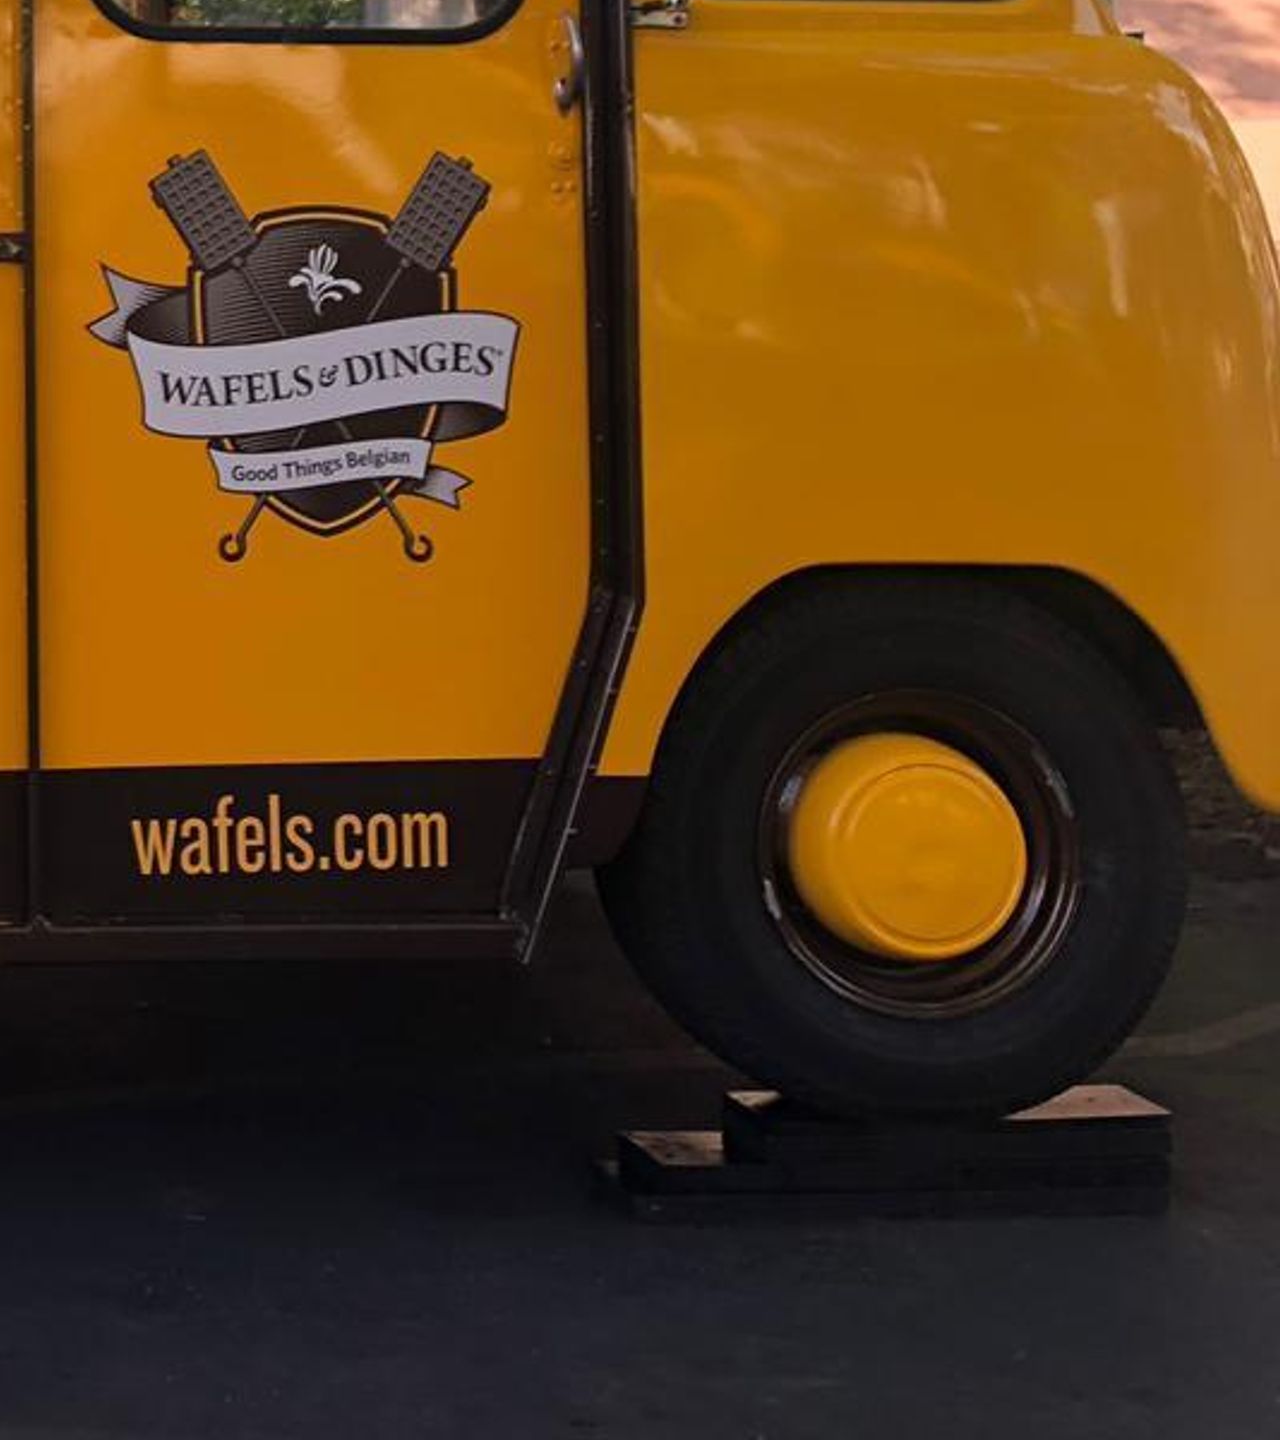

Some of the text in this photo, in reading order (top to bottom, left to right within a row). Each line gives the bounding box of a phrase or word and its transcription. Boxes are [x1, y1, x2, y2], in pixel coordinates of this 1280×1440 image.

[158, 341, 498, 408] WAFELS & DINGES
[231, 446, 411, 483] Good Things Belgian
[131, 794, 448, 876] wafels.com
